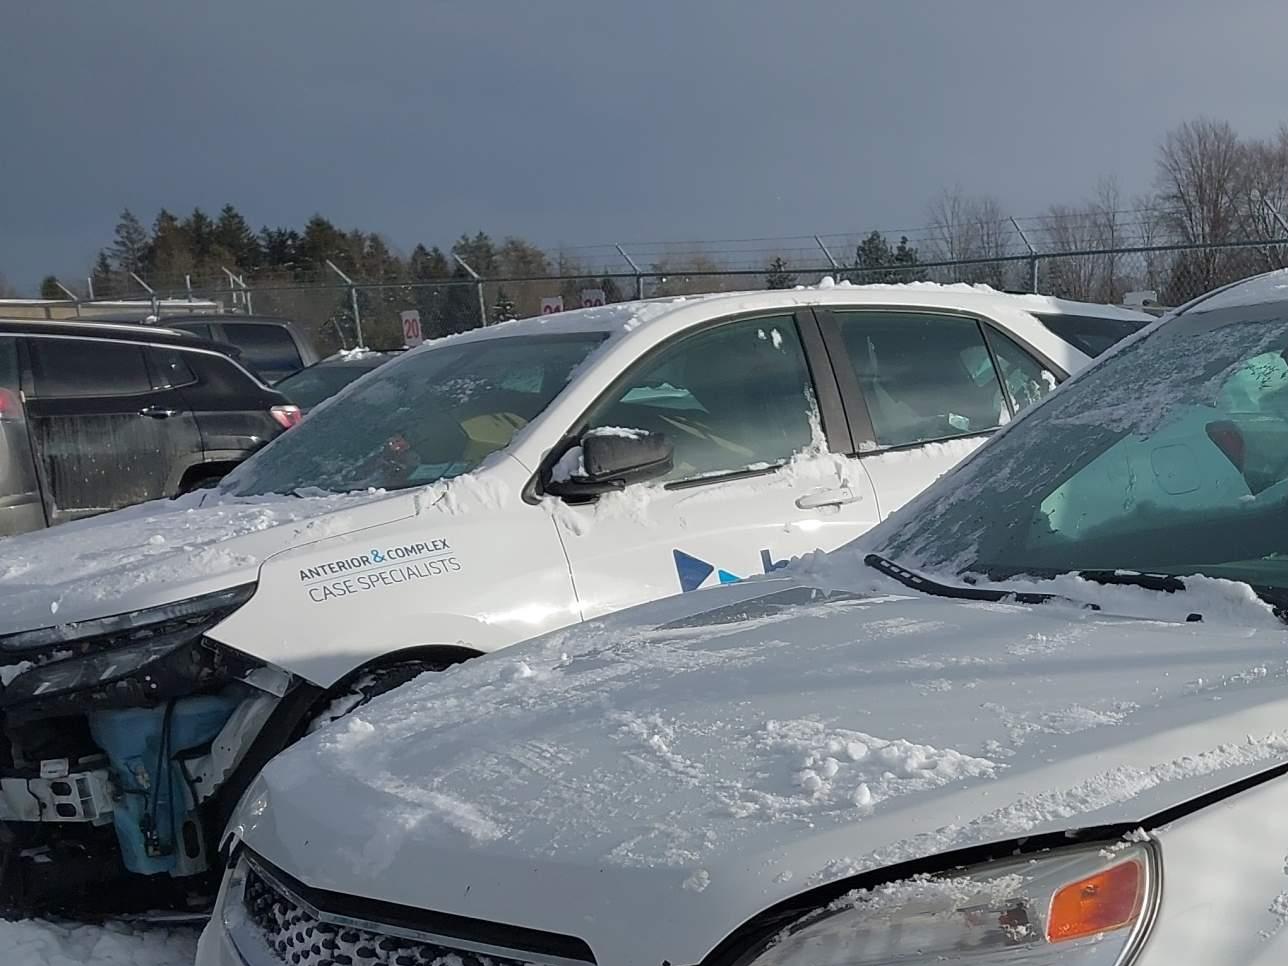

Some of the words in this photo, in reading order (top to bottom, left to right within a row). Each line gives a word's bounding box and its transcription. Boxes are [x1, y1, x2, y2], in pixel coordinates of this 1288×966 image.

[404, 319, 419, 338] 20
[386, 538, 450, 560] COMPLEX
[308, 578, 358, 602] CASE
[357, 557, 462, 590] SPECIALISTS
